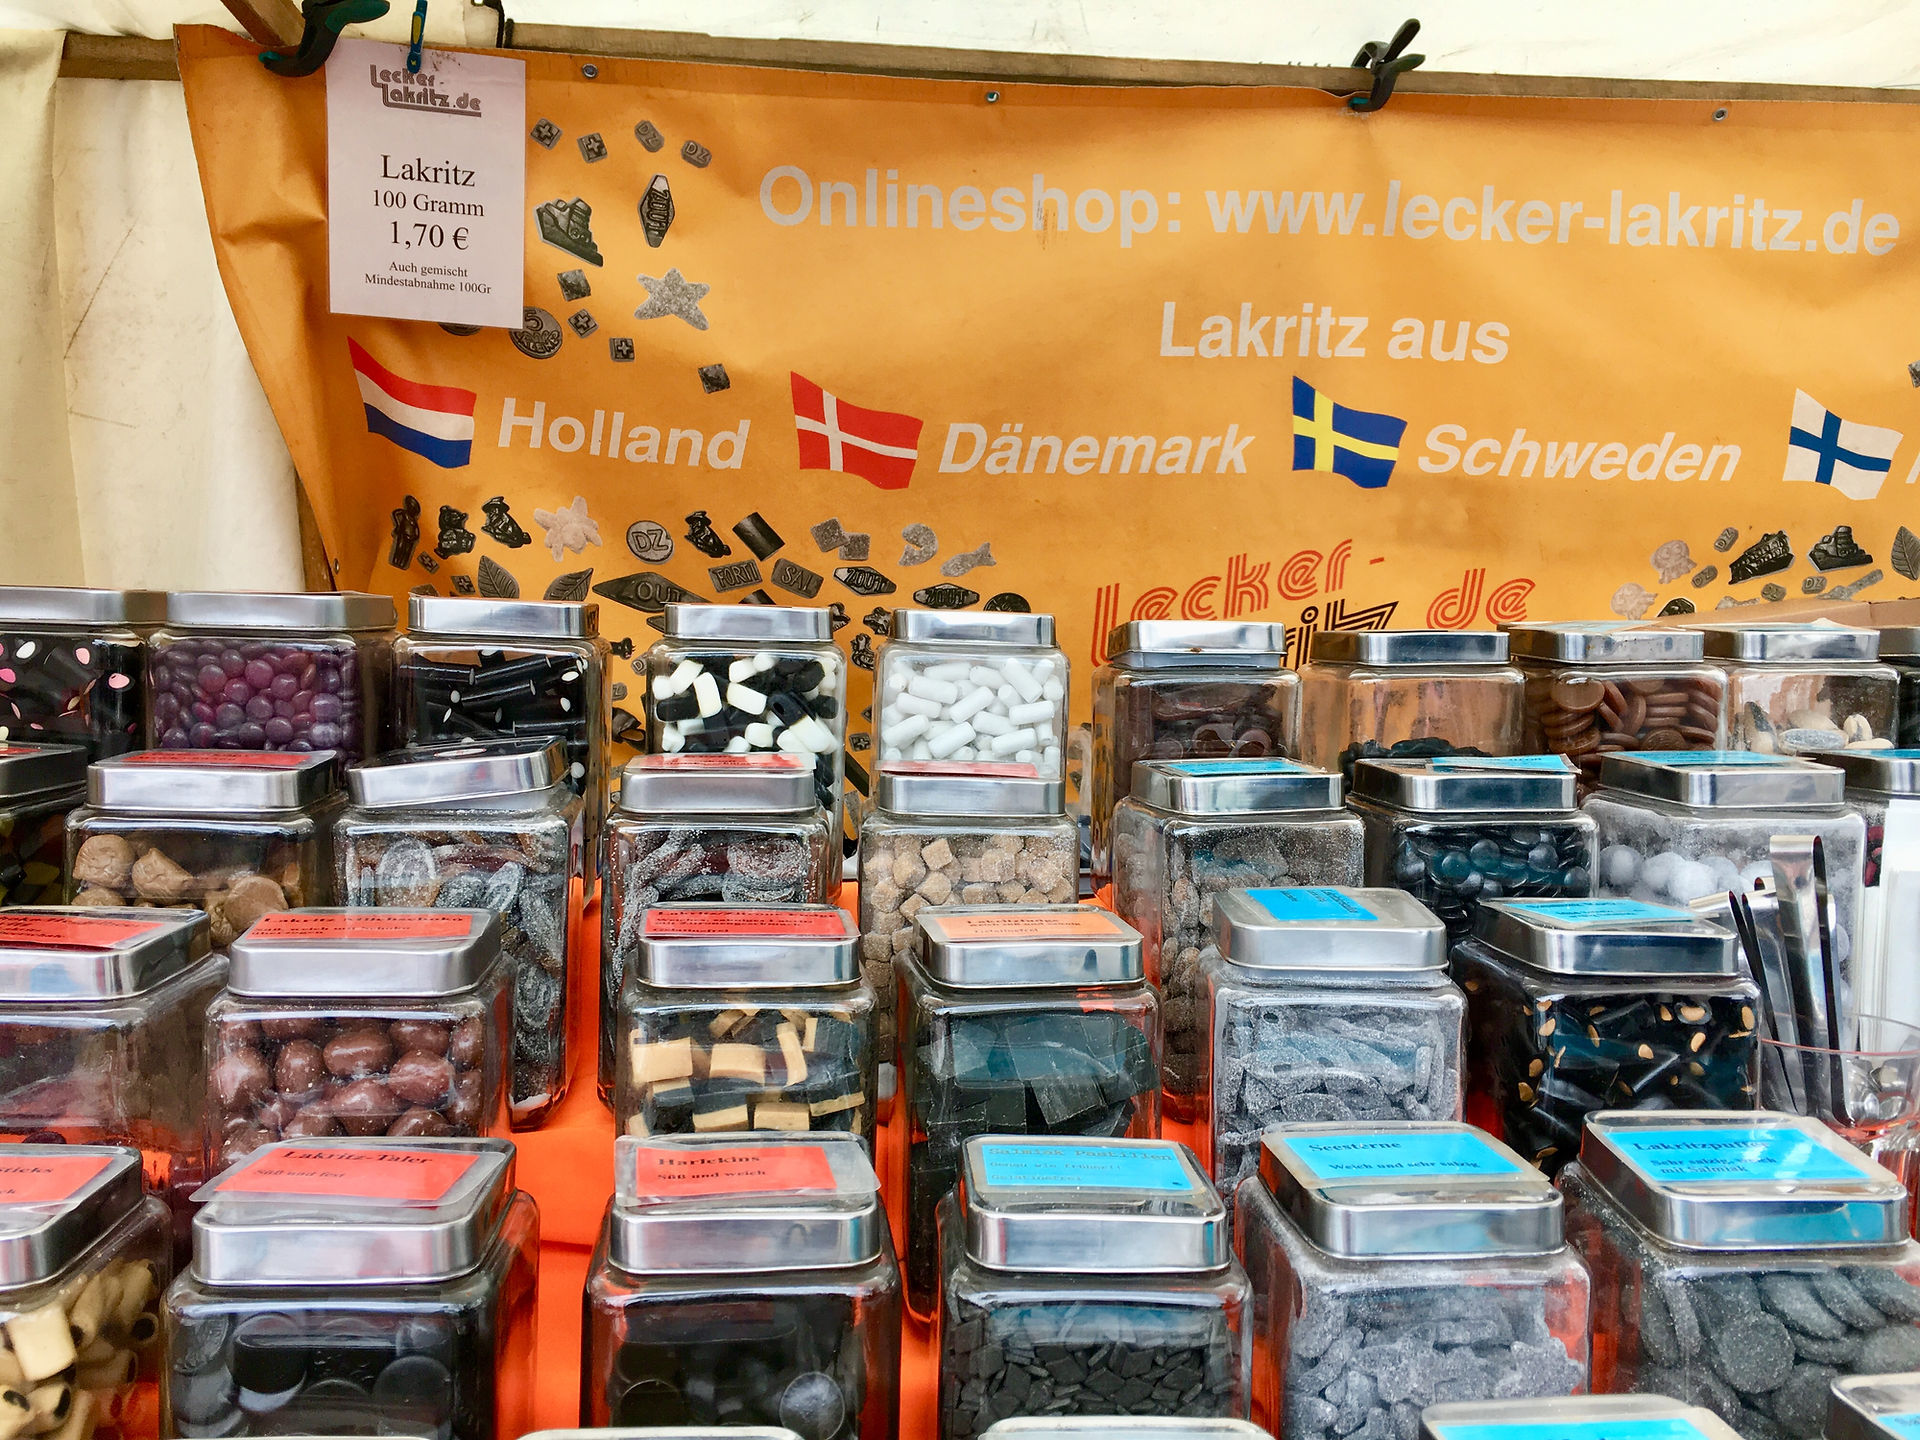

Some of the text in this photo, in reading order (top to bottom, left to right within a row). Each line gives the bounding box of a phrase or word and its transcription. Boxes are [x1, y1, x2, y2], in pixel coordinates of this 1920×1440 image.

[380, 154, 475, 187] Lakritz
[373, 189, 484, 217] 100 Gramm
[760, 165, 1901, 256] Onlineshop: www.lecker-lakritz.de
[391, 221, 469, 250] 1,70 €
[389, 261, 468, 278] Auch gemischt
[365, 273, 492, 294] Mindestabnahme 100Gr
[1159, 301, 1510, 364] Lakritz aus
[497, 397, 1742, 482] Holland Dänemark Schweden
[631, 528, 670, 552] DZ
[282, 1150, 433, 1165] Lakritz-Taler
[1308, 1142, 1402, 1152] Seesterne
[1376, 1161, 1403, 1169] und
[1407, 1160, 1437, 1168] sehr
